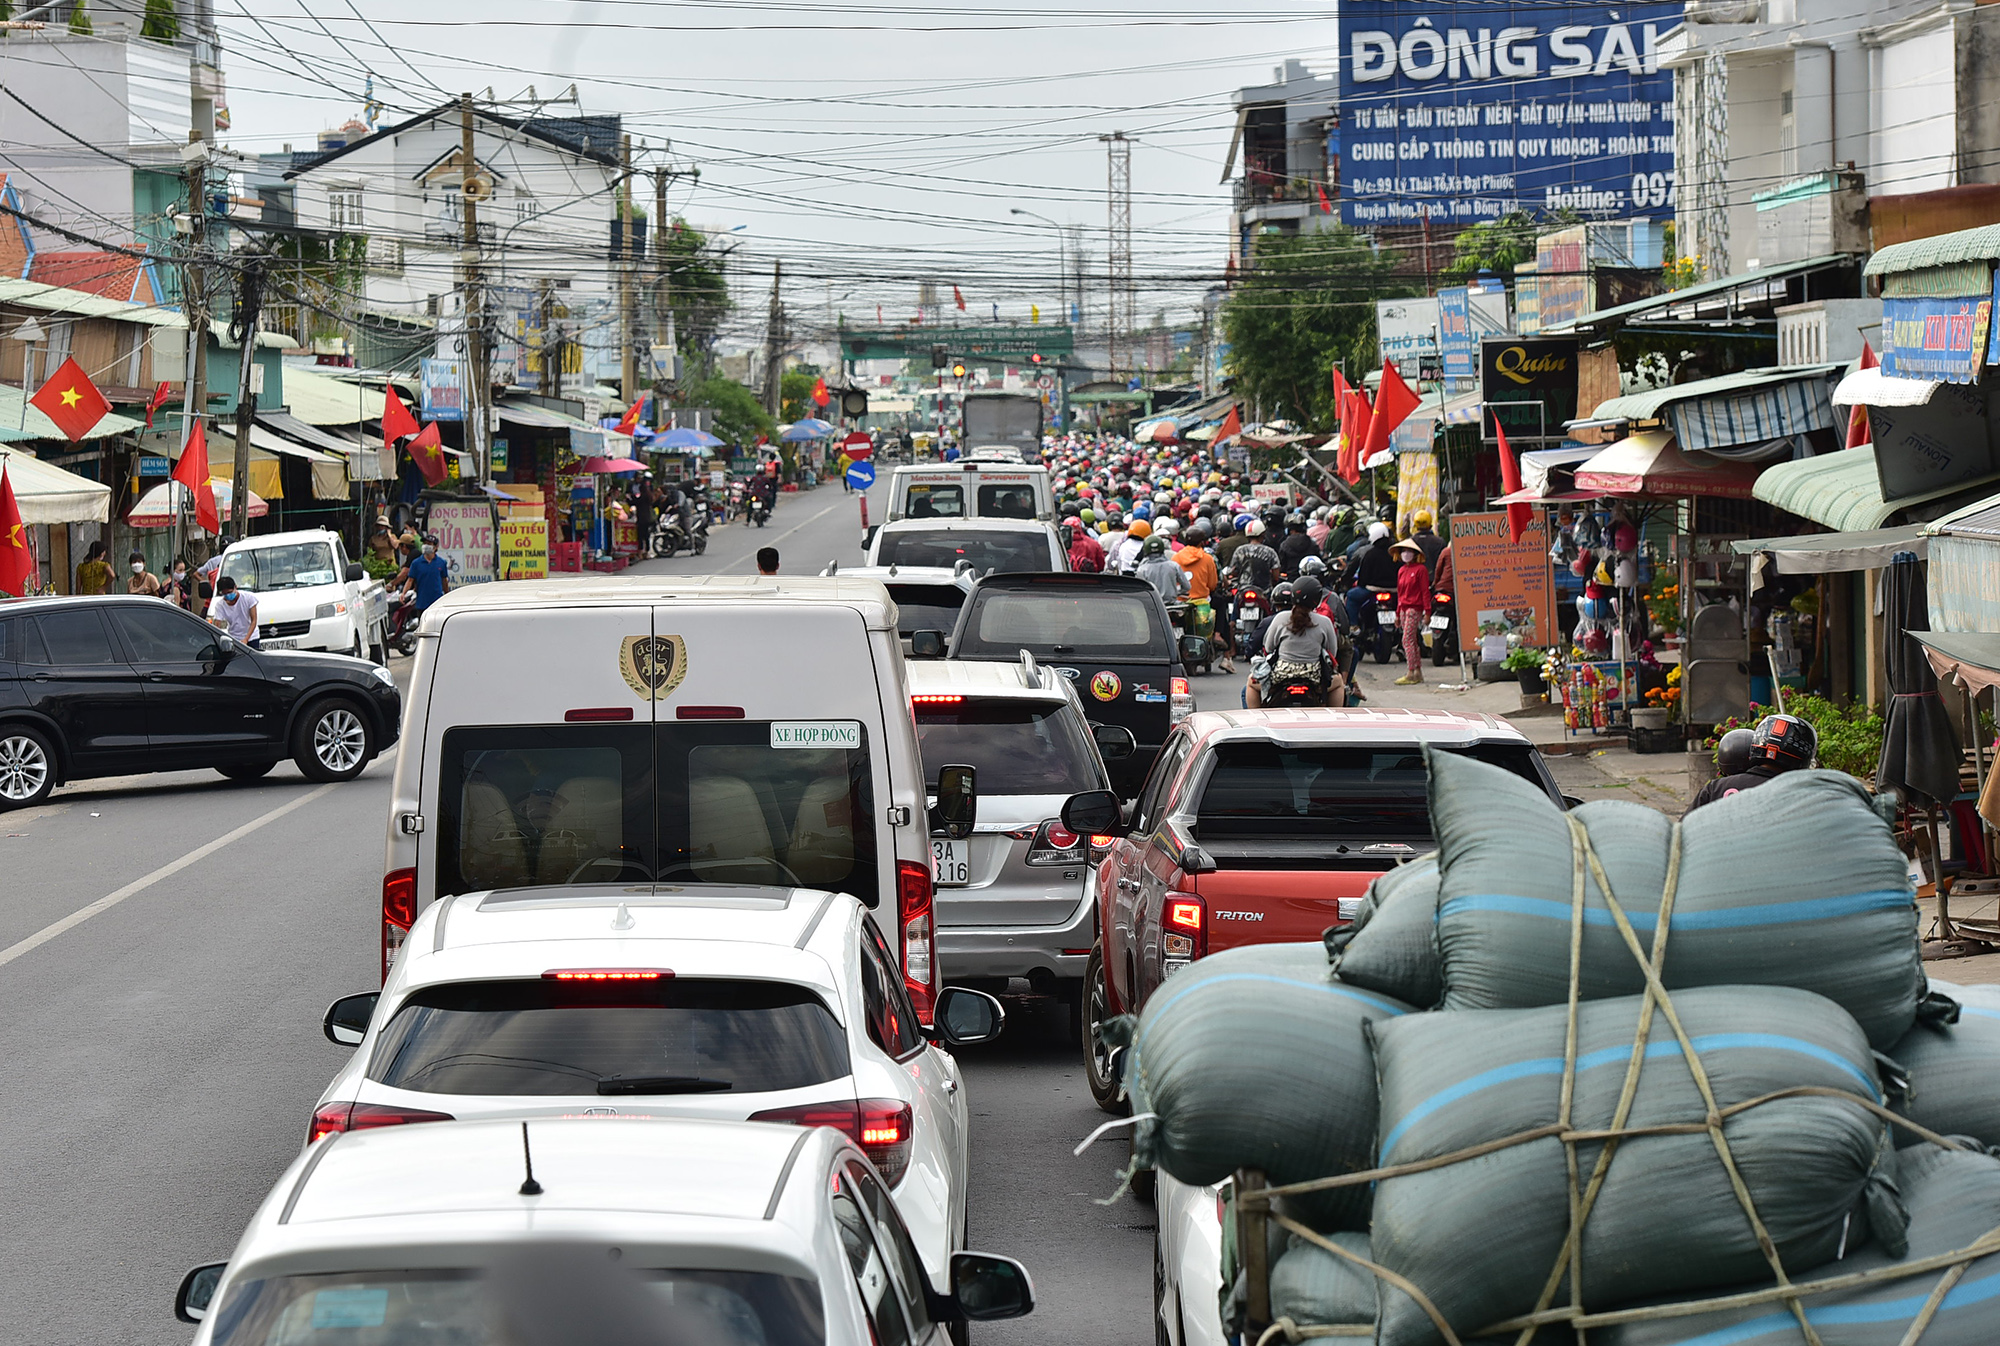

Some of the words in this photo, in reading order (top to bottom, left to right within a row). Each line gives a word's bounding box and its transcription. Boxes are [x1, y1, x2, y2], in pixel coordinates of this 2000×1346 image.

[1351, 17, 1538, 82] ĐÔNG
[1550, 10, 1658, 76] SÀI
[1354, 107, 1372, 129] TƯ
[1521, 99, 1543, 125] ĐẤT
[1352, 142, 1395, 161] CUNG
[1400, 135, 1430, 161] CẤP
[1433, 137, 1485, 160] THÔNG
[1488, 139, 1514, 158] TIN
[1518, 138, 1548, 159] QUY
[1551, 137, 1600, 160] HOẠCH
[1608, 132, 1648, 155] HOÀN
[1394, 177, 1406, 193] Lý
[1409, 175, 1432, 192] Thái
[1464, 174, 1481, 194] Đại
[1482, 174, 1515, 191] Phước
[1545, 185, 1625, 210] Hotline:
[1354, 202, 1386, 221] Huyện
[1388, 203, 1414, 218] Nhơn
[1449, 199, 1472, 217] Tỉnh
[1473, 197, 1500, 218] Đồng
[1382, 331, 1413, 351] PHỞ
[1923, 314, 1948, 351] KIM
[1495, 346, 1568, 385] Quán
[1492, 389, 1573, 426] CHAY
[429, 507, 459, 519] LONG
[428, 520, 464, 550] SỬA
[468, 526, 491, 549] XE
[500, 522, 518, 535] HỦ
[520, 522, 545, 535] TIẾU
[1477, 519, 1497, 536] CHAY
[1488, 542, 1507, 550] CUNG
[465, 554, 480, 569] TAY
[525, 560, 538, 568] NUI
[459, 574, 492, 584] YAMAHA
[524, 570, 544, 579] CANH
[774, 727, 792, 742] XE
[794, 726, 819, 745] HỢP
[821, 723, 857, 743] ĐỒNG
[1215, 910, 1264, 921] TRITON
